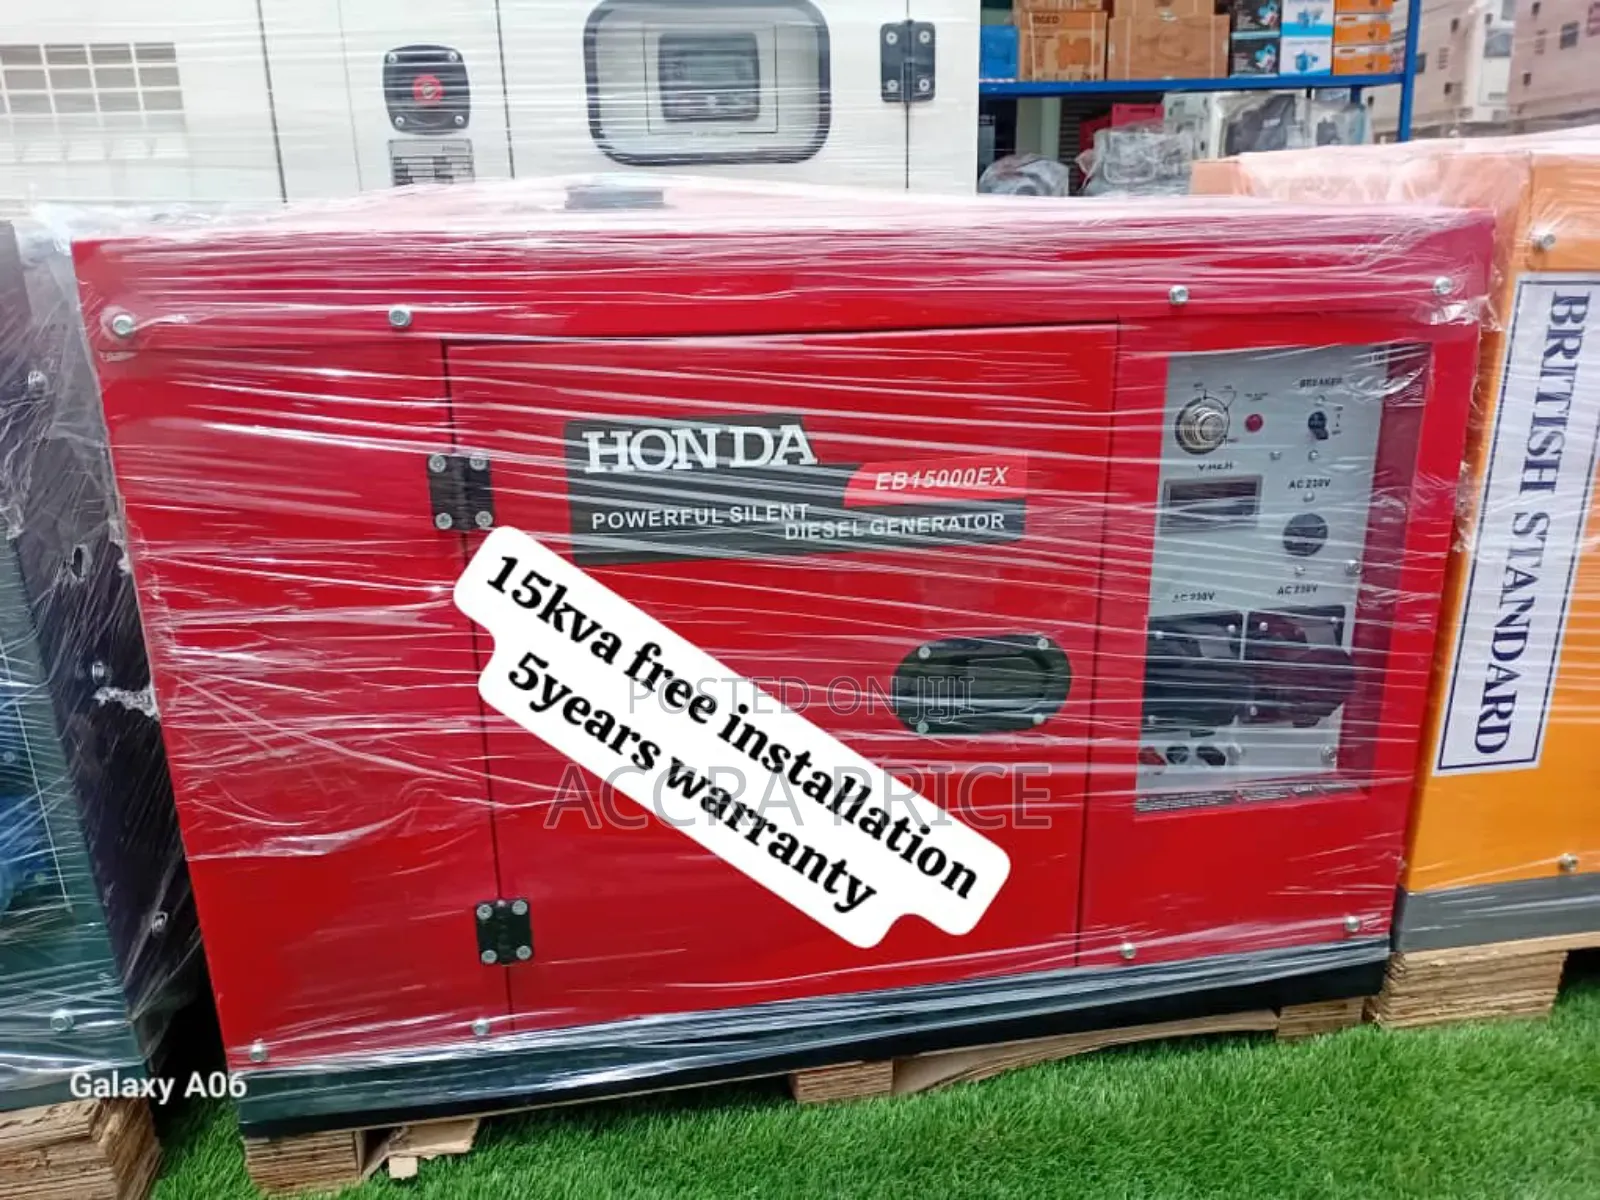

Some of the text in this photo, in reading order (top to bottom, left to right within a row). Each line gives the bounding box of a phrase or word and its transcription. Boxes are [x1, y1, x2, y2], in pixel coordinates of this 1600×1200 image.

[581, 424, 818, 474] HONDA
[875, 466, 1008, 491] EB15000EX
[1288, 479, 1303, 489] AC
[592, 503, 810, 529] POWERFUL SILENT
[785, 512, 1005, 540] DIESEL GENERATOR
[1474, 290, 1590, 755] BRITISH STANDARD
[1277, 586, 1292, 595] AC
